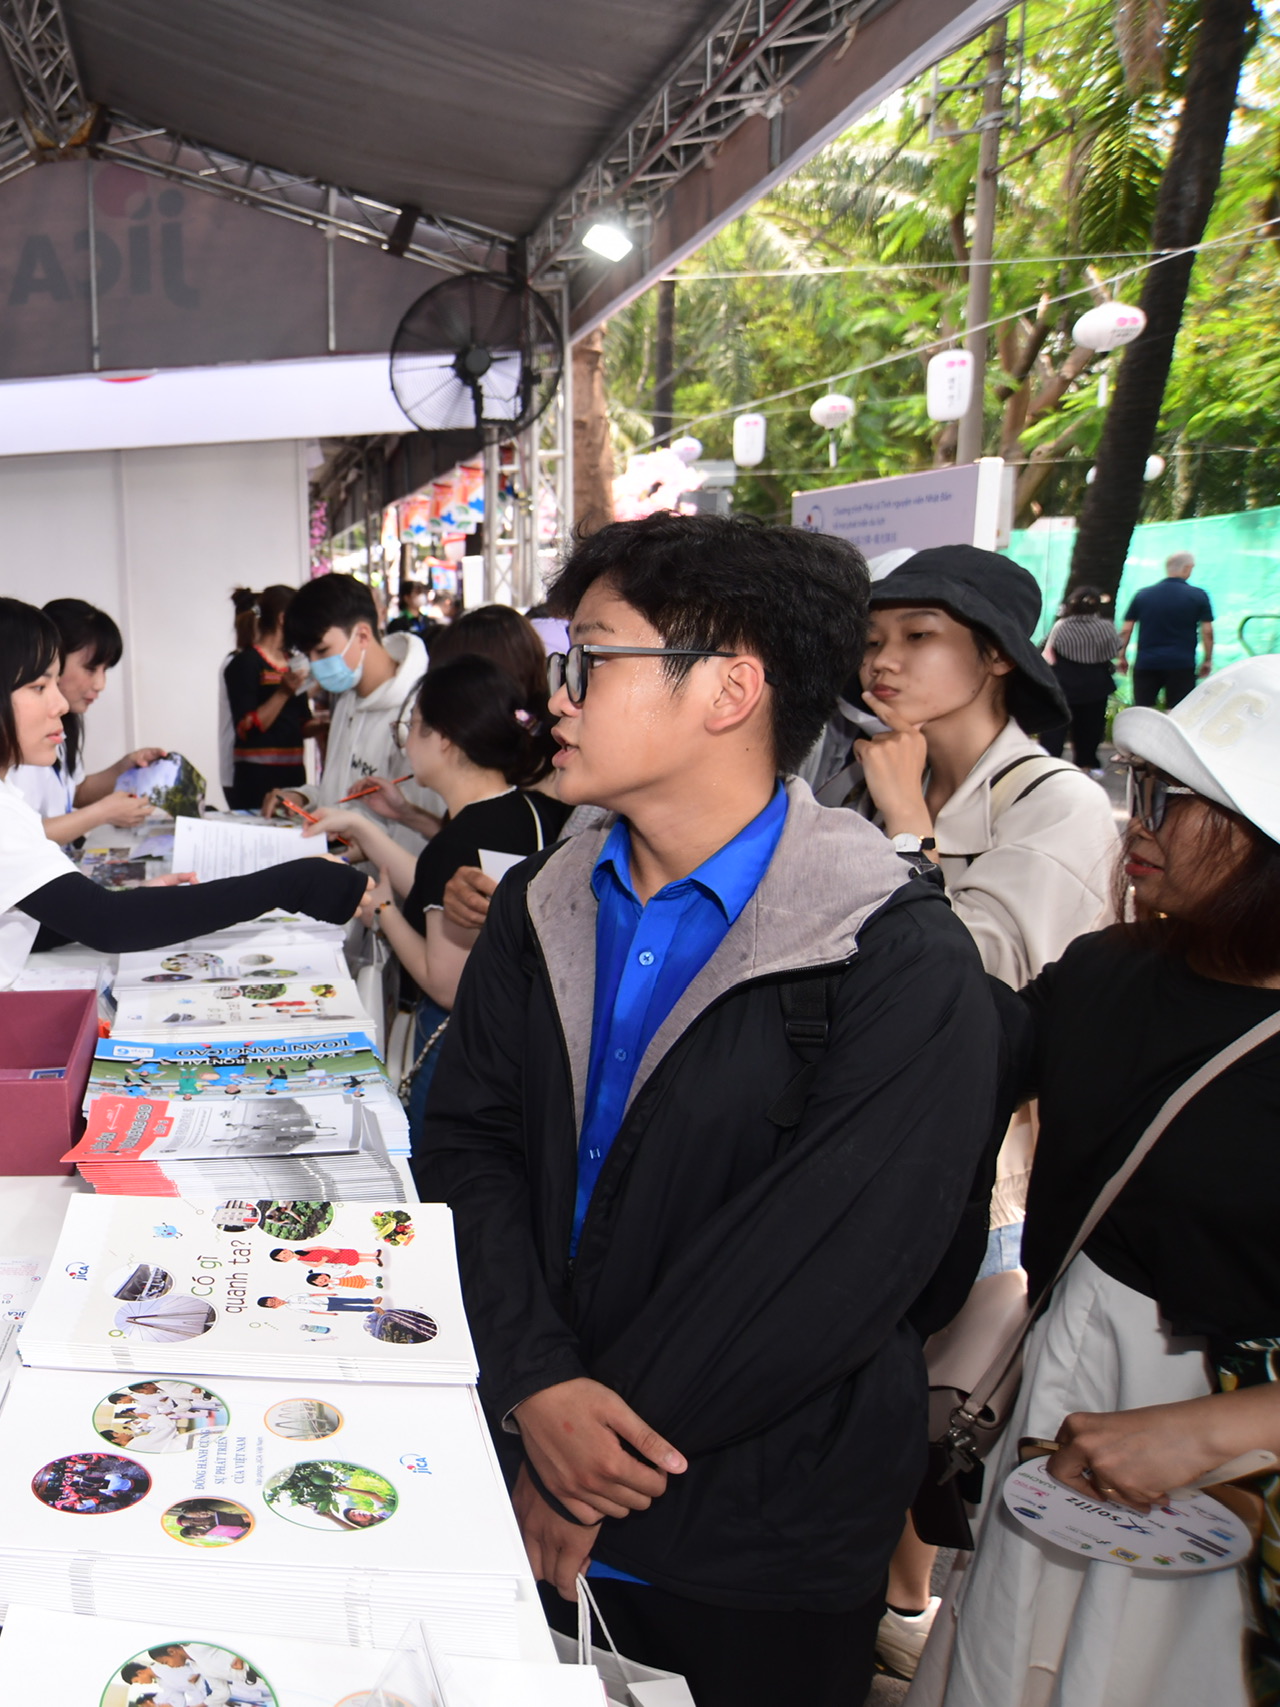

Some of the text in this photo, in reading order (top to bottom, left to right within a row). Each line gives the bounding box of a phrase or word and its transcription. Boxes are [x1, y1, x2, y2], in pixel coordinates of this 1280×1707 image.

[191, 1254, 223, 1297] Có gì
[225, 1239, 254, 1315] quanh ta?
[235, 1436, 246, 1453] NAM
[233, 1453, 247, 1469] VIỆT
[1065, 1496, 1123, 1522] sojitz
